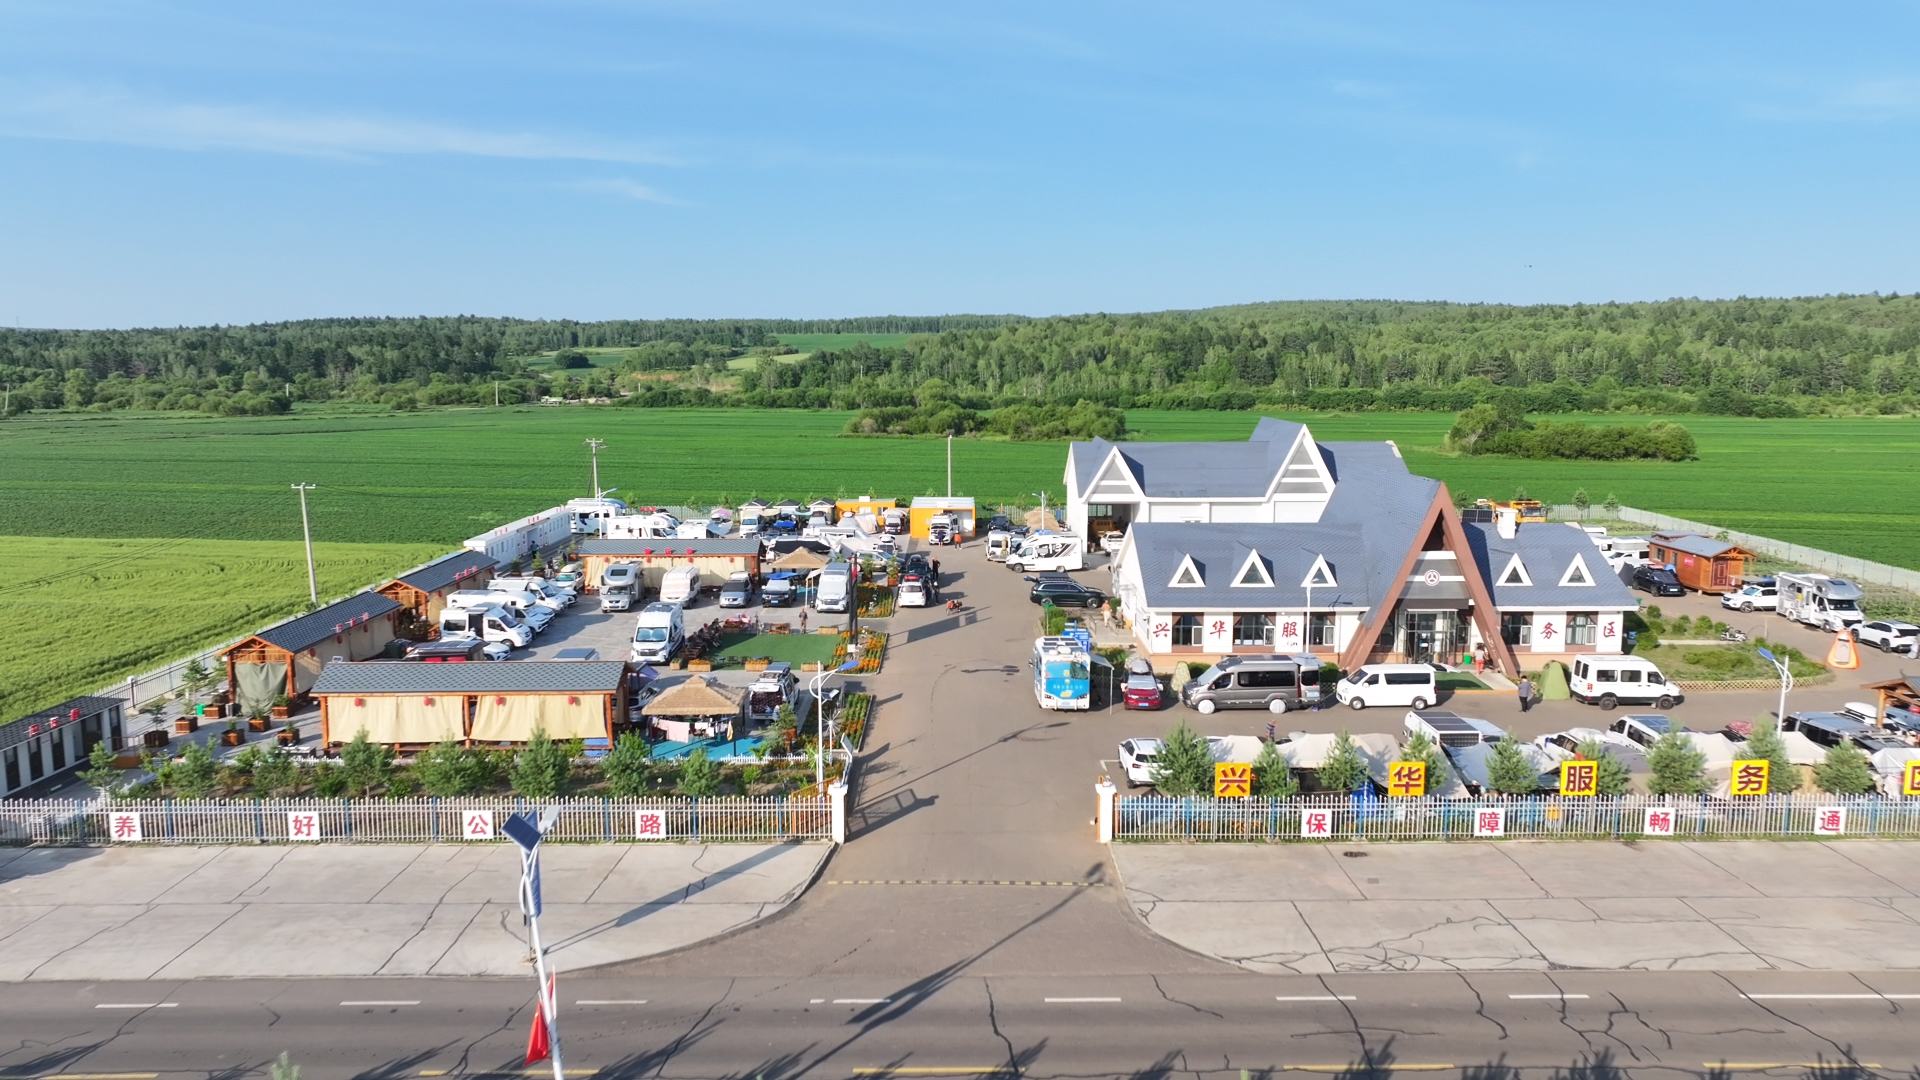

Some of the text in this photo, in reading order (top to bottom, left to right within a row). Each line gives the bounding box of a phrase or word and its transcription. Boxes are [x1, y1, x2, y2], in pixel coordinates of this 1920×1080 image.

[1219, 764, 1765, 794] 兴 华 服 务
[114, 813, 662, 838] 养 好 公 路
[1305, 810, 1841, 834] 保 障 畅 通
